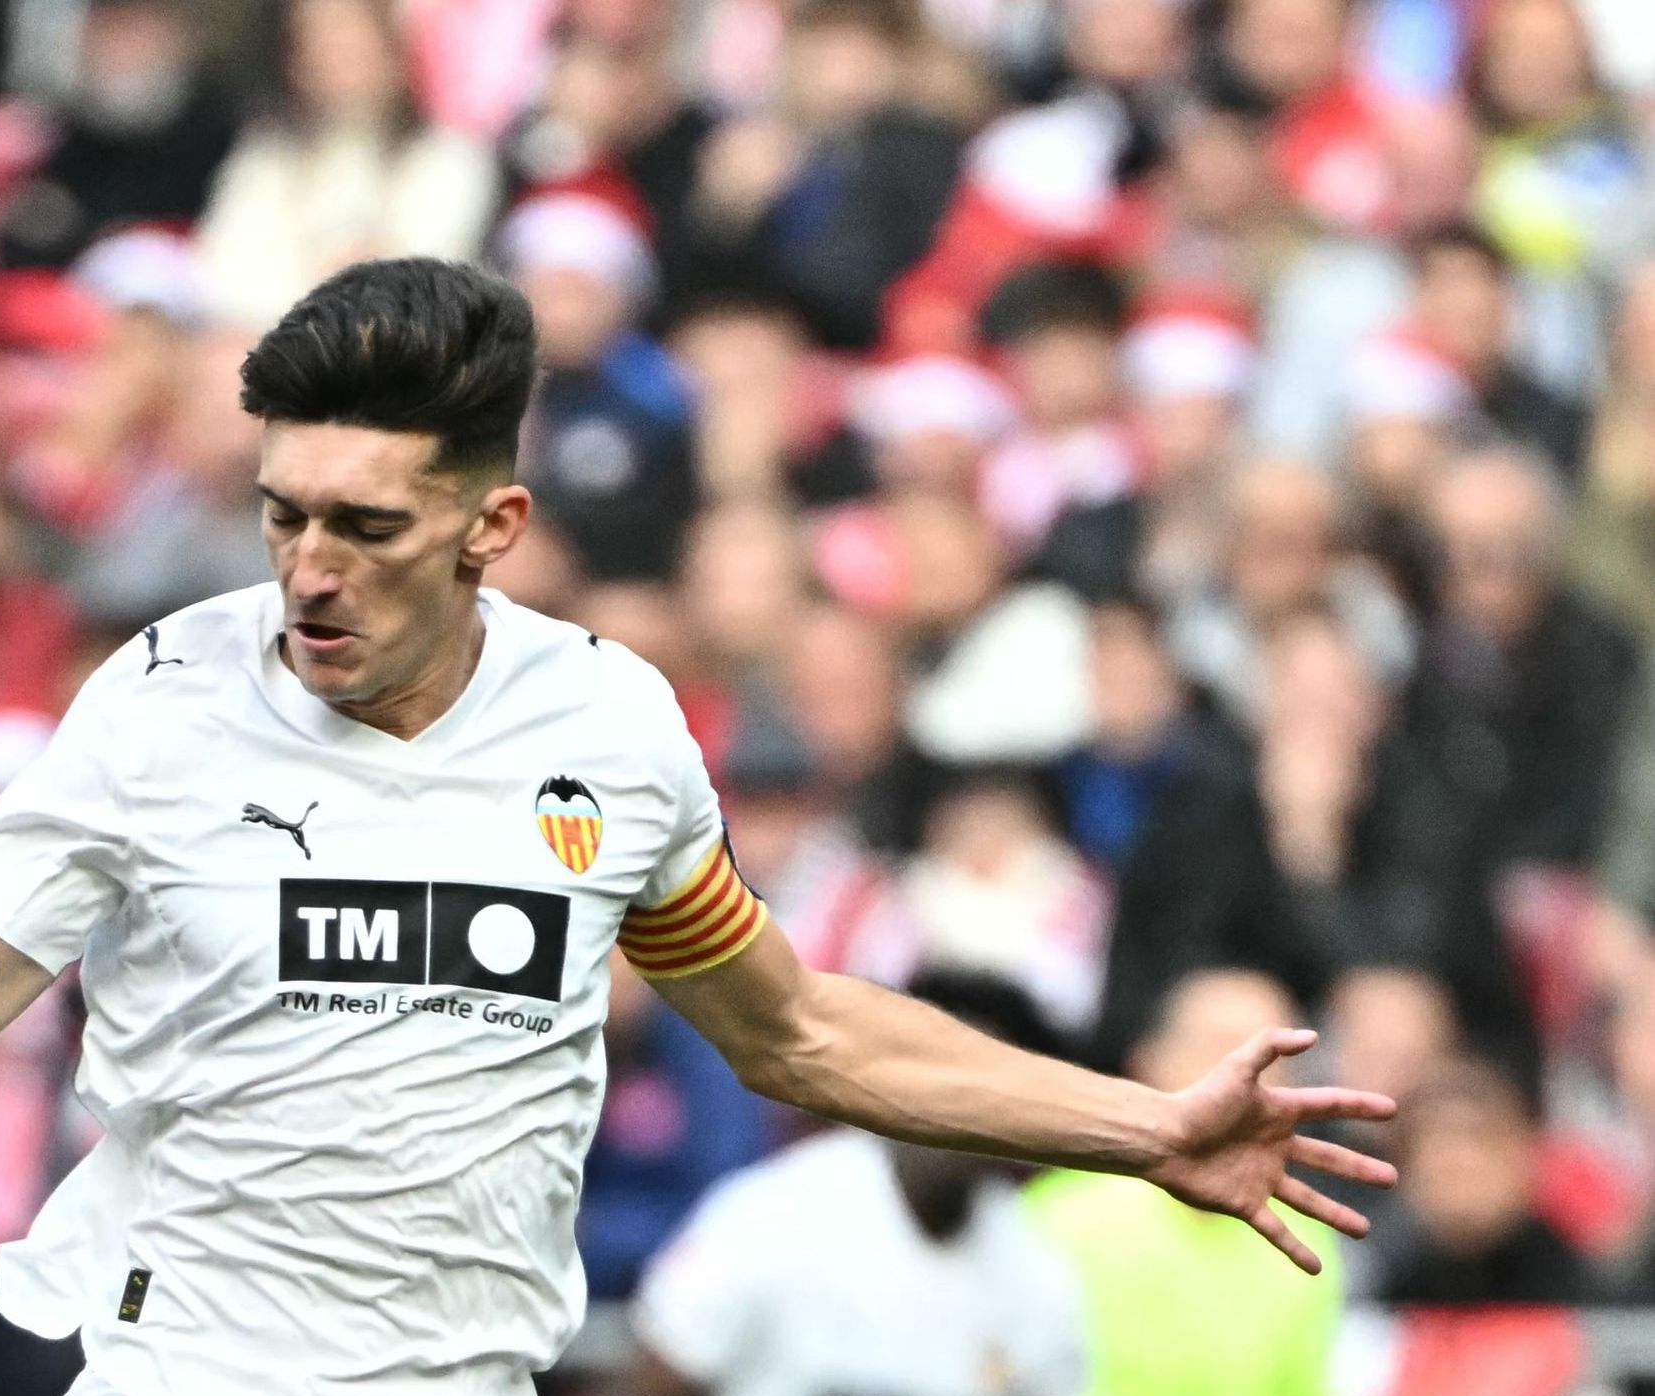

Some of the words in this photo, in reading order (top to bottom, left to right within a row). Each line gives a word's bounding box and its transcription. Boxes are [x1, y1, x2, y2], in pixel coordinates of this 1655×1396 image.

[296, 905, 400, 963] TM
[275, 991, 319, 1014] TM
[328, 992, 386, 1015] Real
[396, 995, 473, 1019] Estate
[482, 1002, 553, 1036] Group
